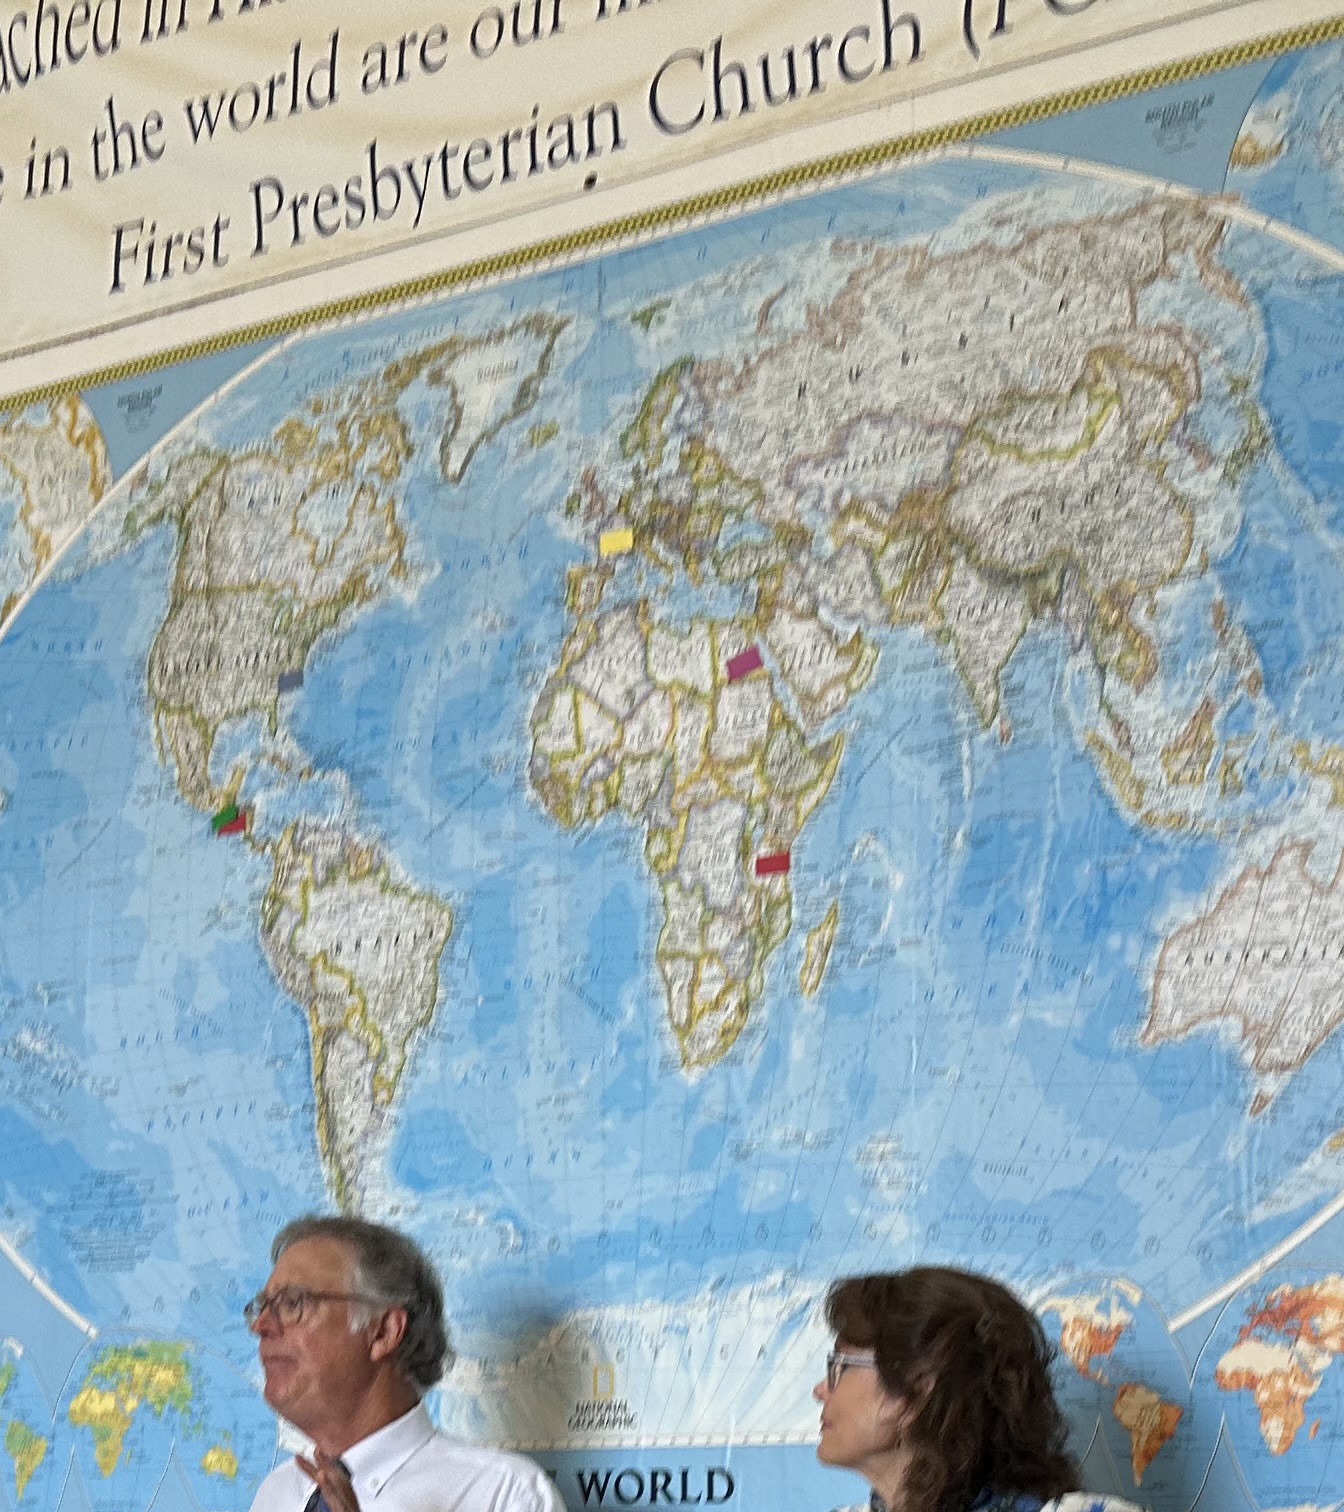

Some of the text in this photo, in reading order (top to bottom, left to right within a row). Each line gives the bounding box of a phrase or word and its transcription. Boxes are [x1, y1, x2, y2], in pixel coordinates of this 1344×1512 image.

[24, 136, 73, 202] in
[91, 96, 166, 182] the
[183, 28, 341, 145] world
[362, 22, 449, 94] are
[109, 210, 231, 295] First
[249, 99, 629, 260] Presbyterian
[648, 0, 925, 134] Church
[576, 1465, 736, 1506] WORLD
